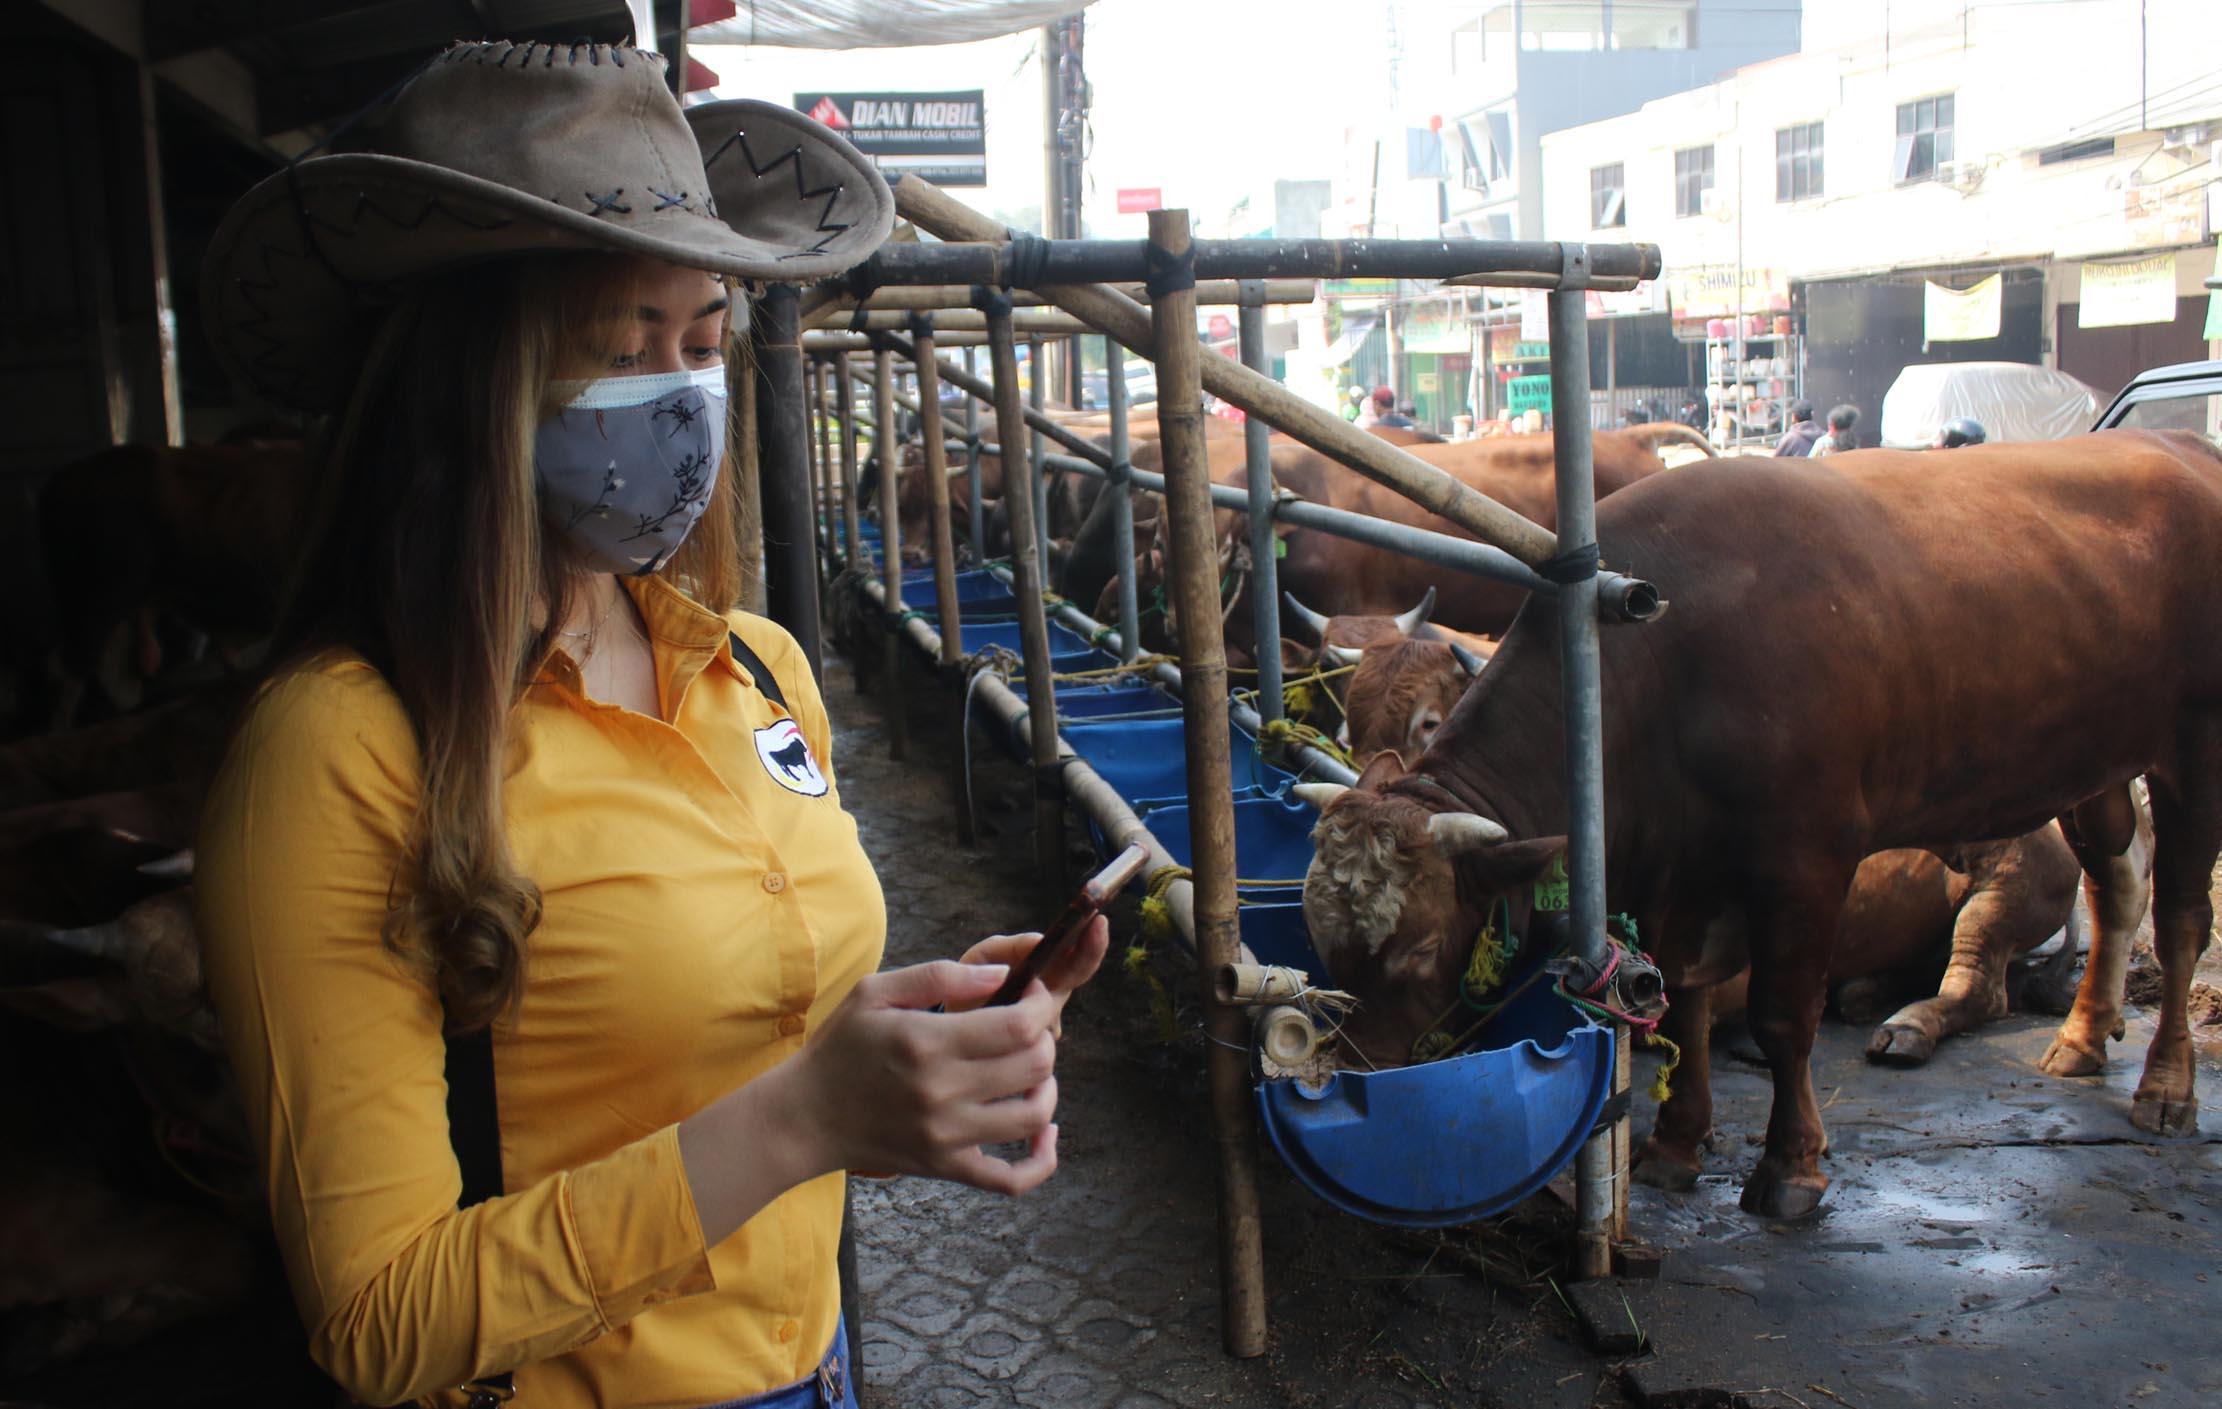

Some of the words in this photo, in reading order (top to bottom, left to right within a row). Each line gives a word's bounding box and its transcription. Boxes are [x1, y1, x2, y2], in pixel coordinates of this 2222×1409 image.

[852, 100, 906, 126] DIAN
[911, 101, 979, 126] MOBIL
[1511, 381, 1550, 398] YONO
